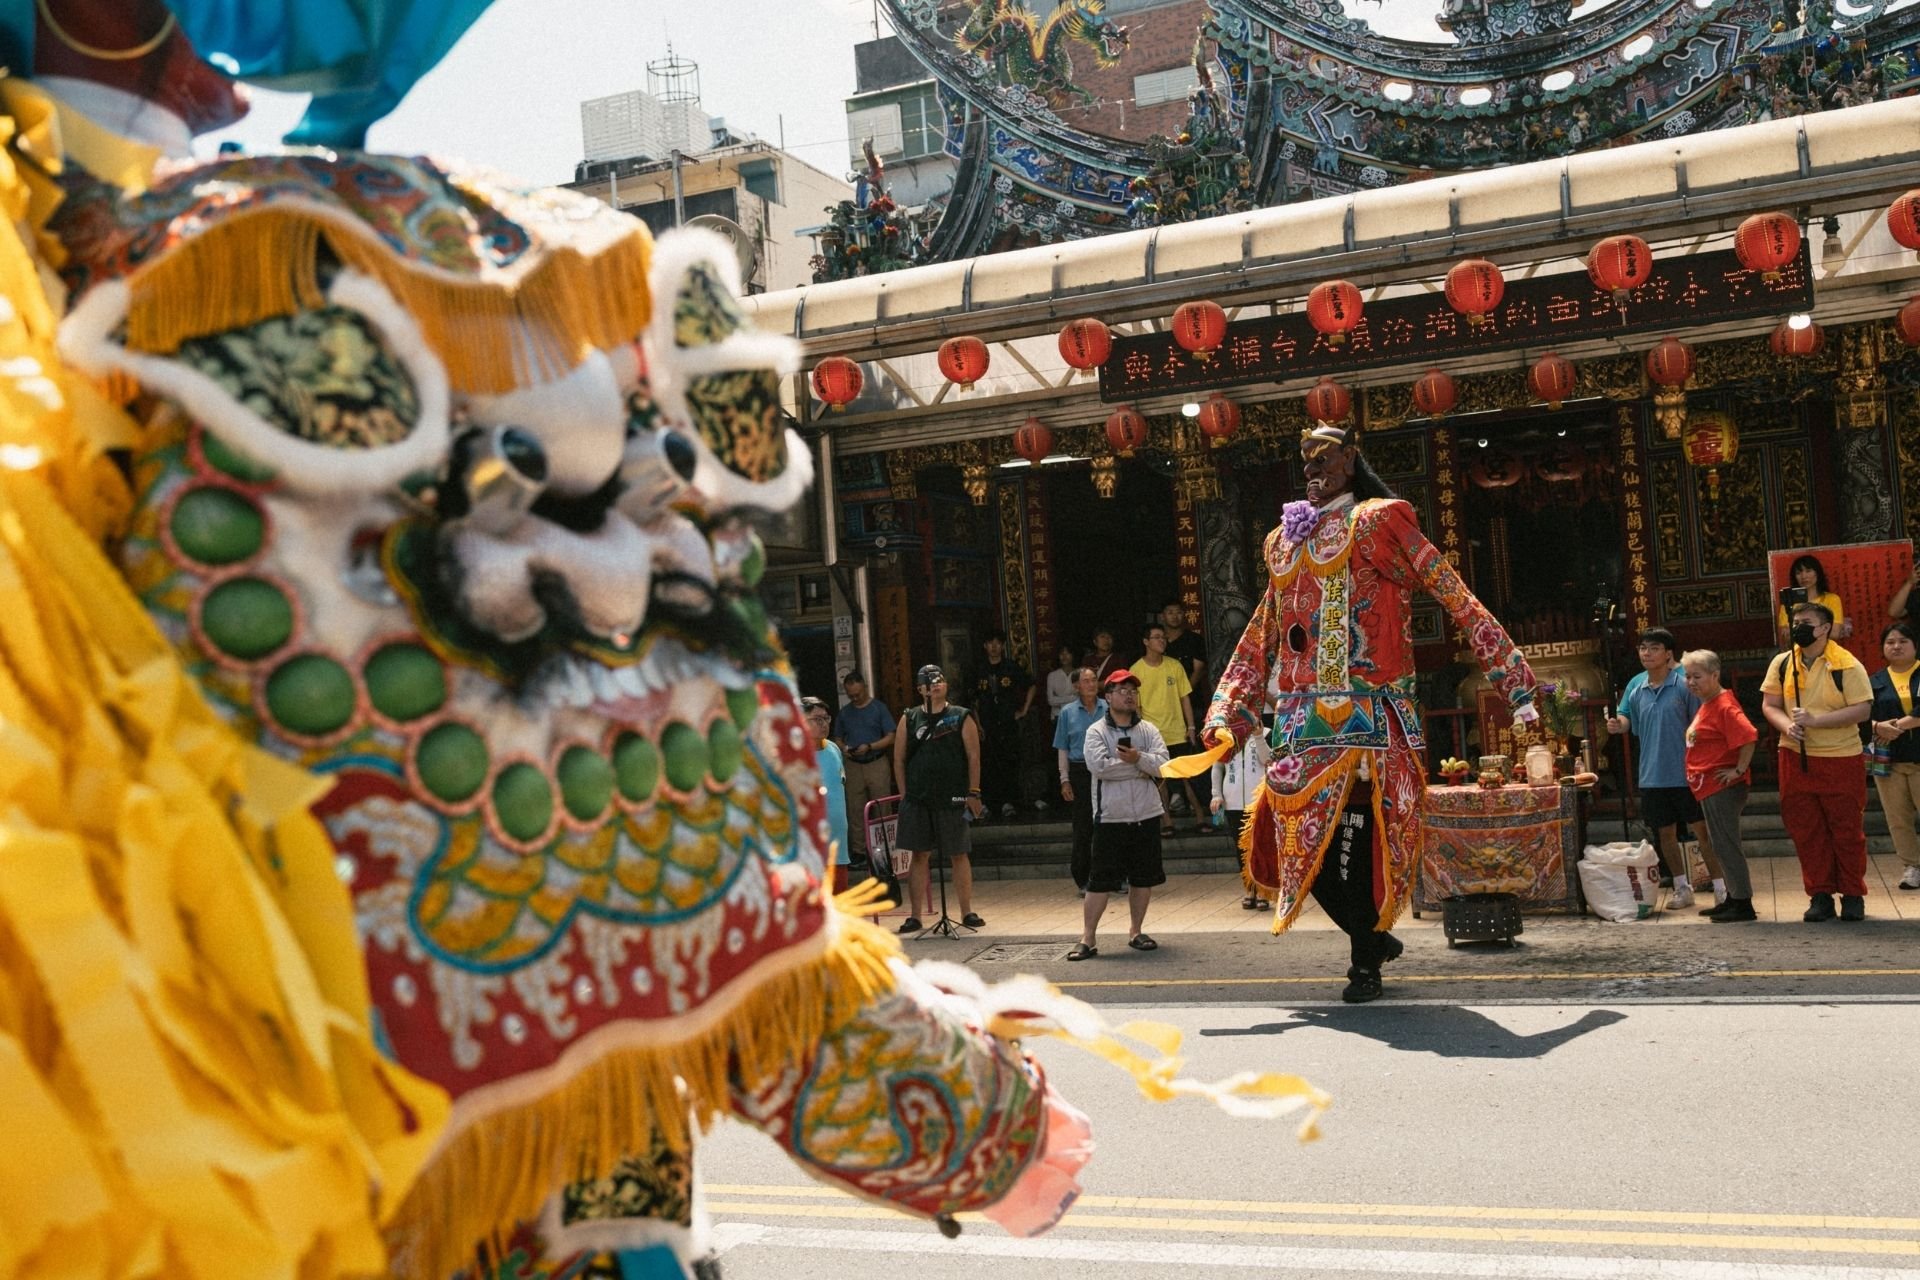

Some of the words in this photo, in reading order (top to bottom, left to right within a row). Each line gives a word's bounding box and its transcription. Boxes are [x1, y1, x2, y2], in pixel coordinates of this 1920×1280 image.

[1624, 239, 1637, 277] 天上聖母
[1331, 284, 1344, 320] 天上聖母
[1322, 580, 1344, 686] 侯聖會館
